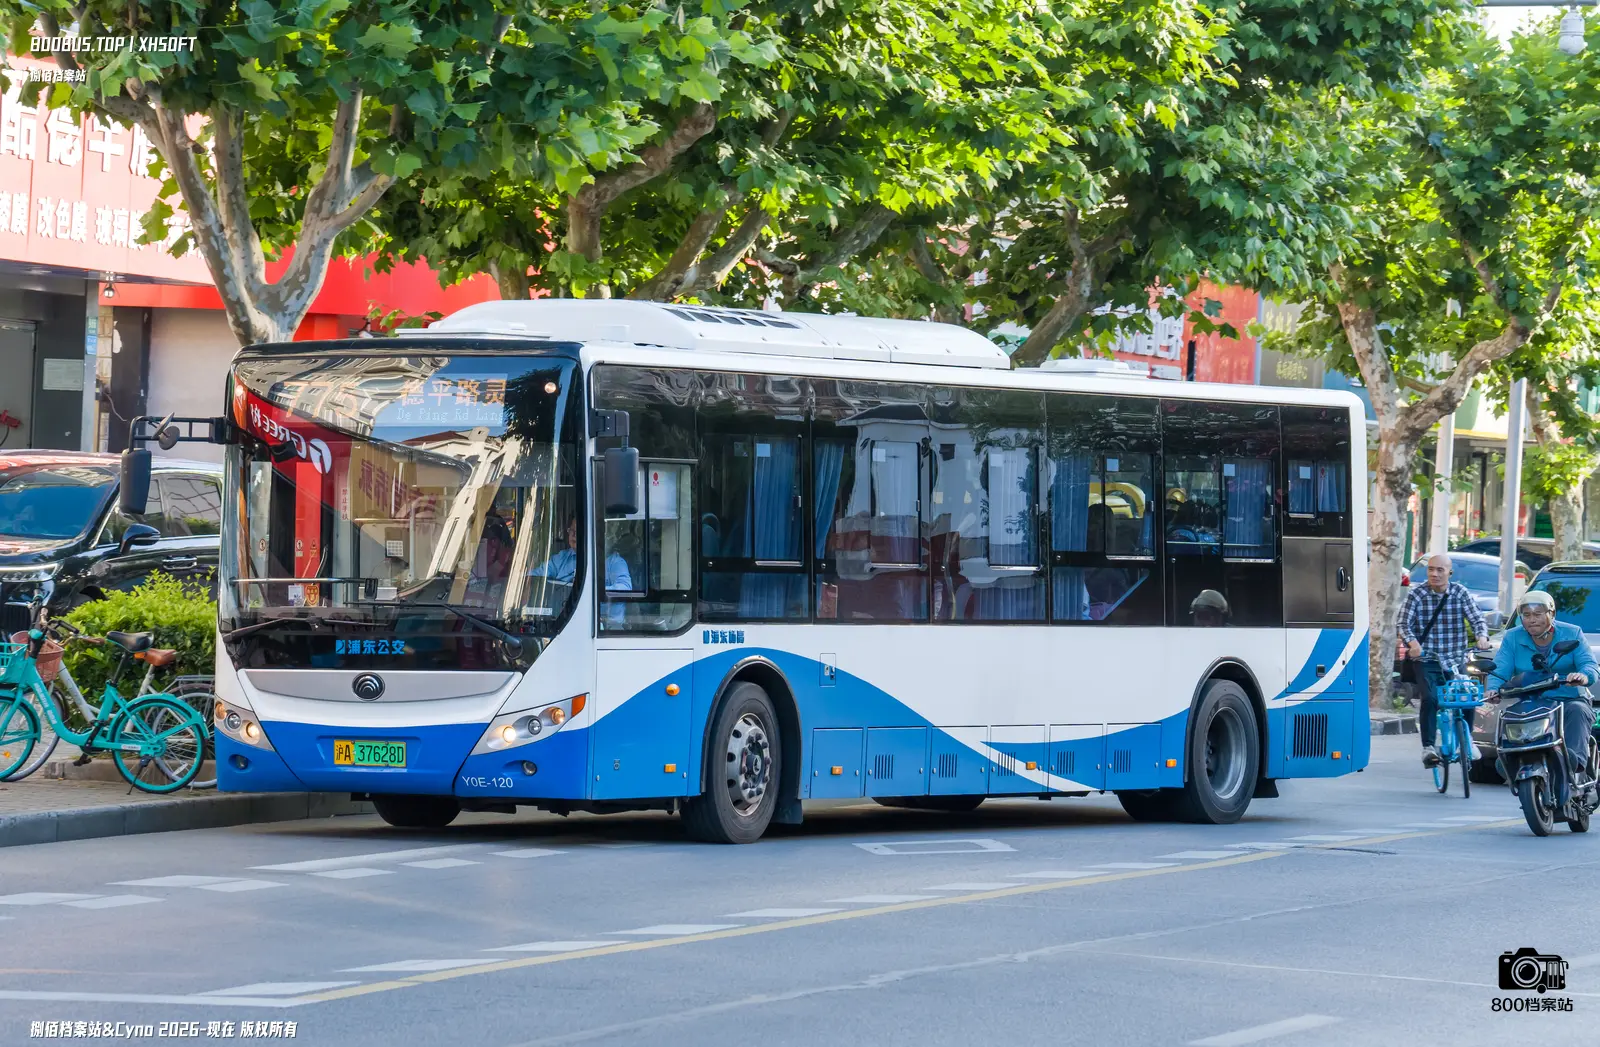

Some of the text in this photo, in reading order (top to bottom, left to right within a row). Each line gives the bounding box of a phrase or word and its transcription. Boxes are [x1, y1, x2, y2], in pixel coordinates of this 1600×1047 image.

[37, 196, 89, 244] 改色膜
[396, 407, 411, 420] De
[420, 408, 449, 423] Ping
[455, 407, 469, 420] Rd
[347, 639, 405, 655] 浦东公交
